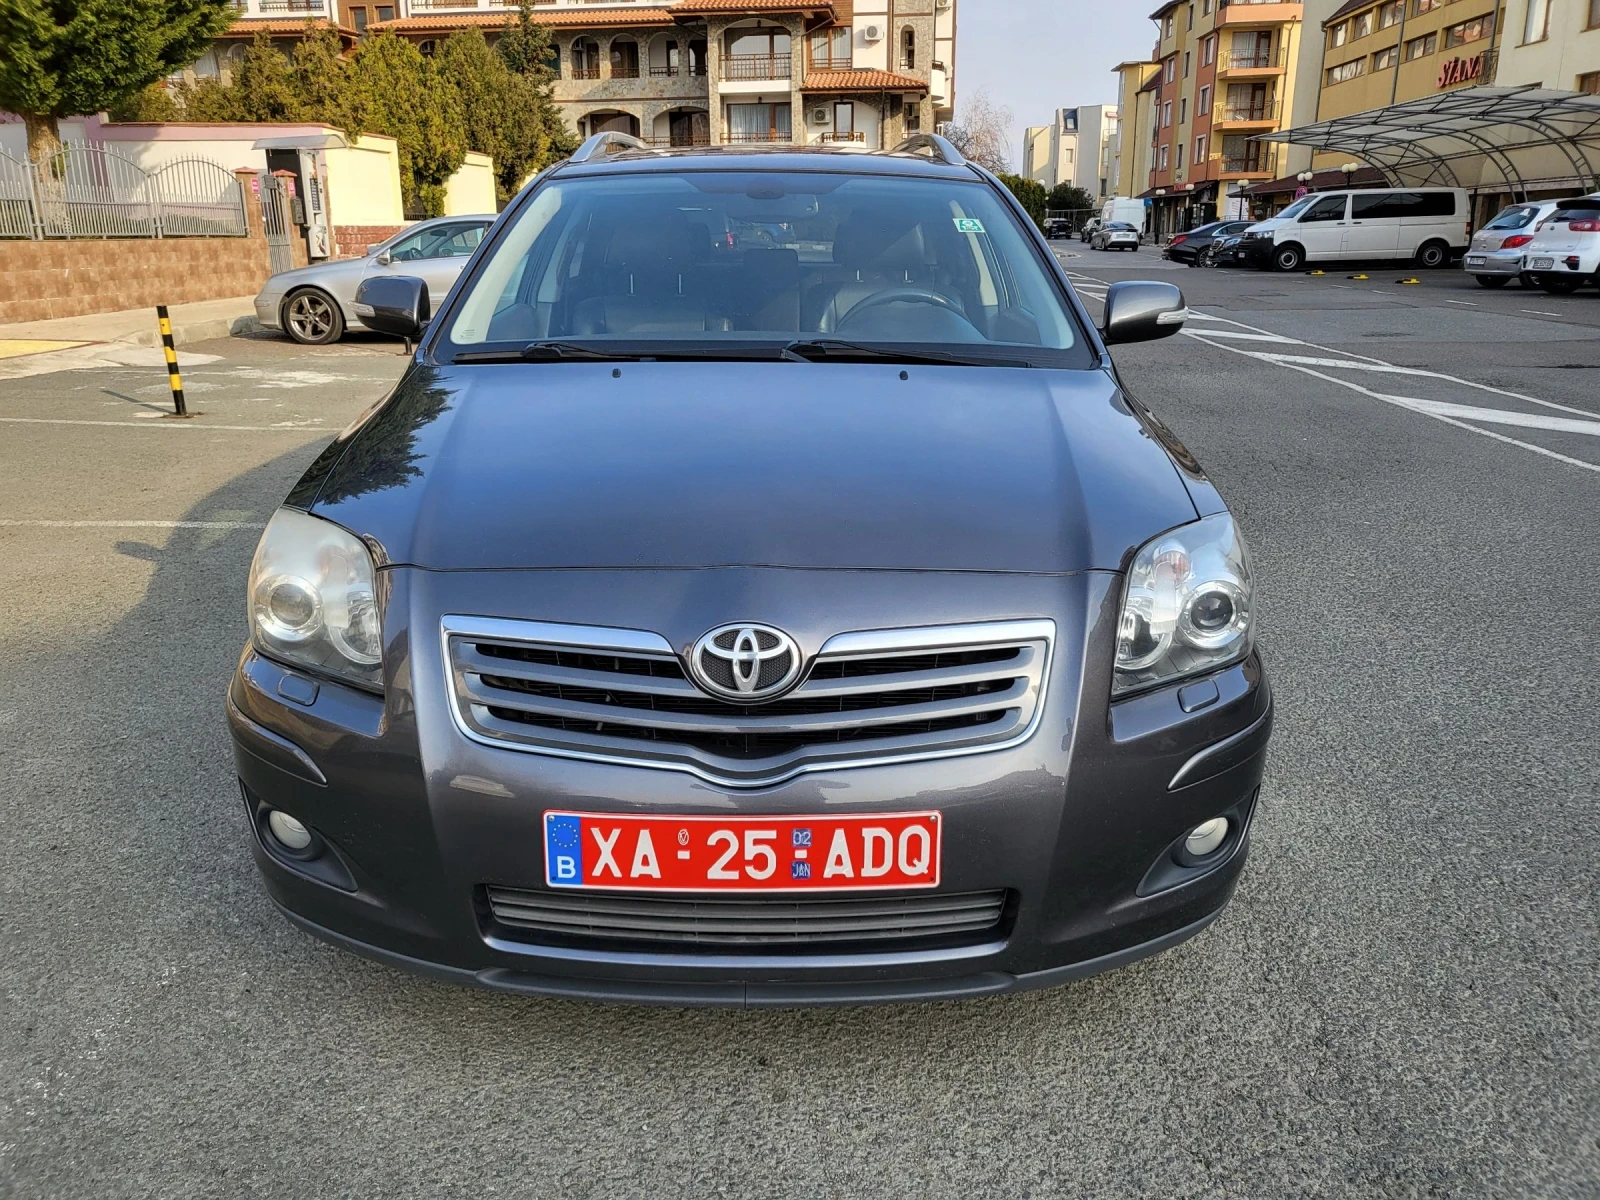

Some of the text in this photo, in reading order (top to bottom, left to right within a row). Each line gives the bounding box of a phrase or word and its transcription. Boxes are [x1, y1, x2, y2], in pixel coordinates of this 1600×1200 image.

[793, 831, 811, 845] 02
[557, 855, 576, 878] B
[793, 863, 811, 877] JAN
